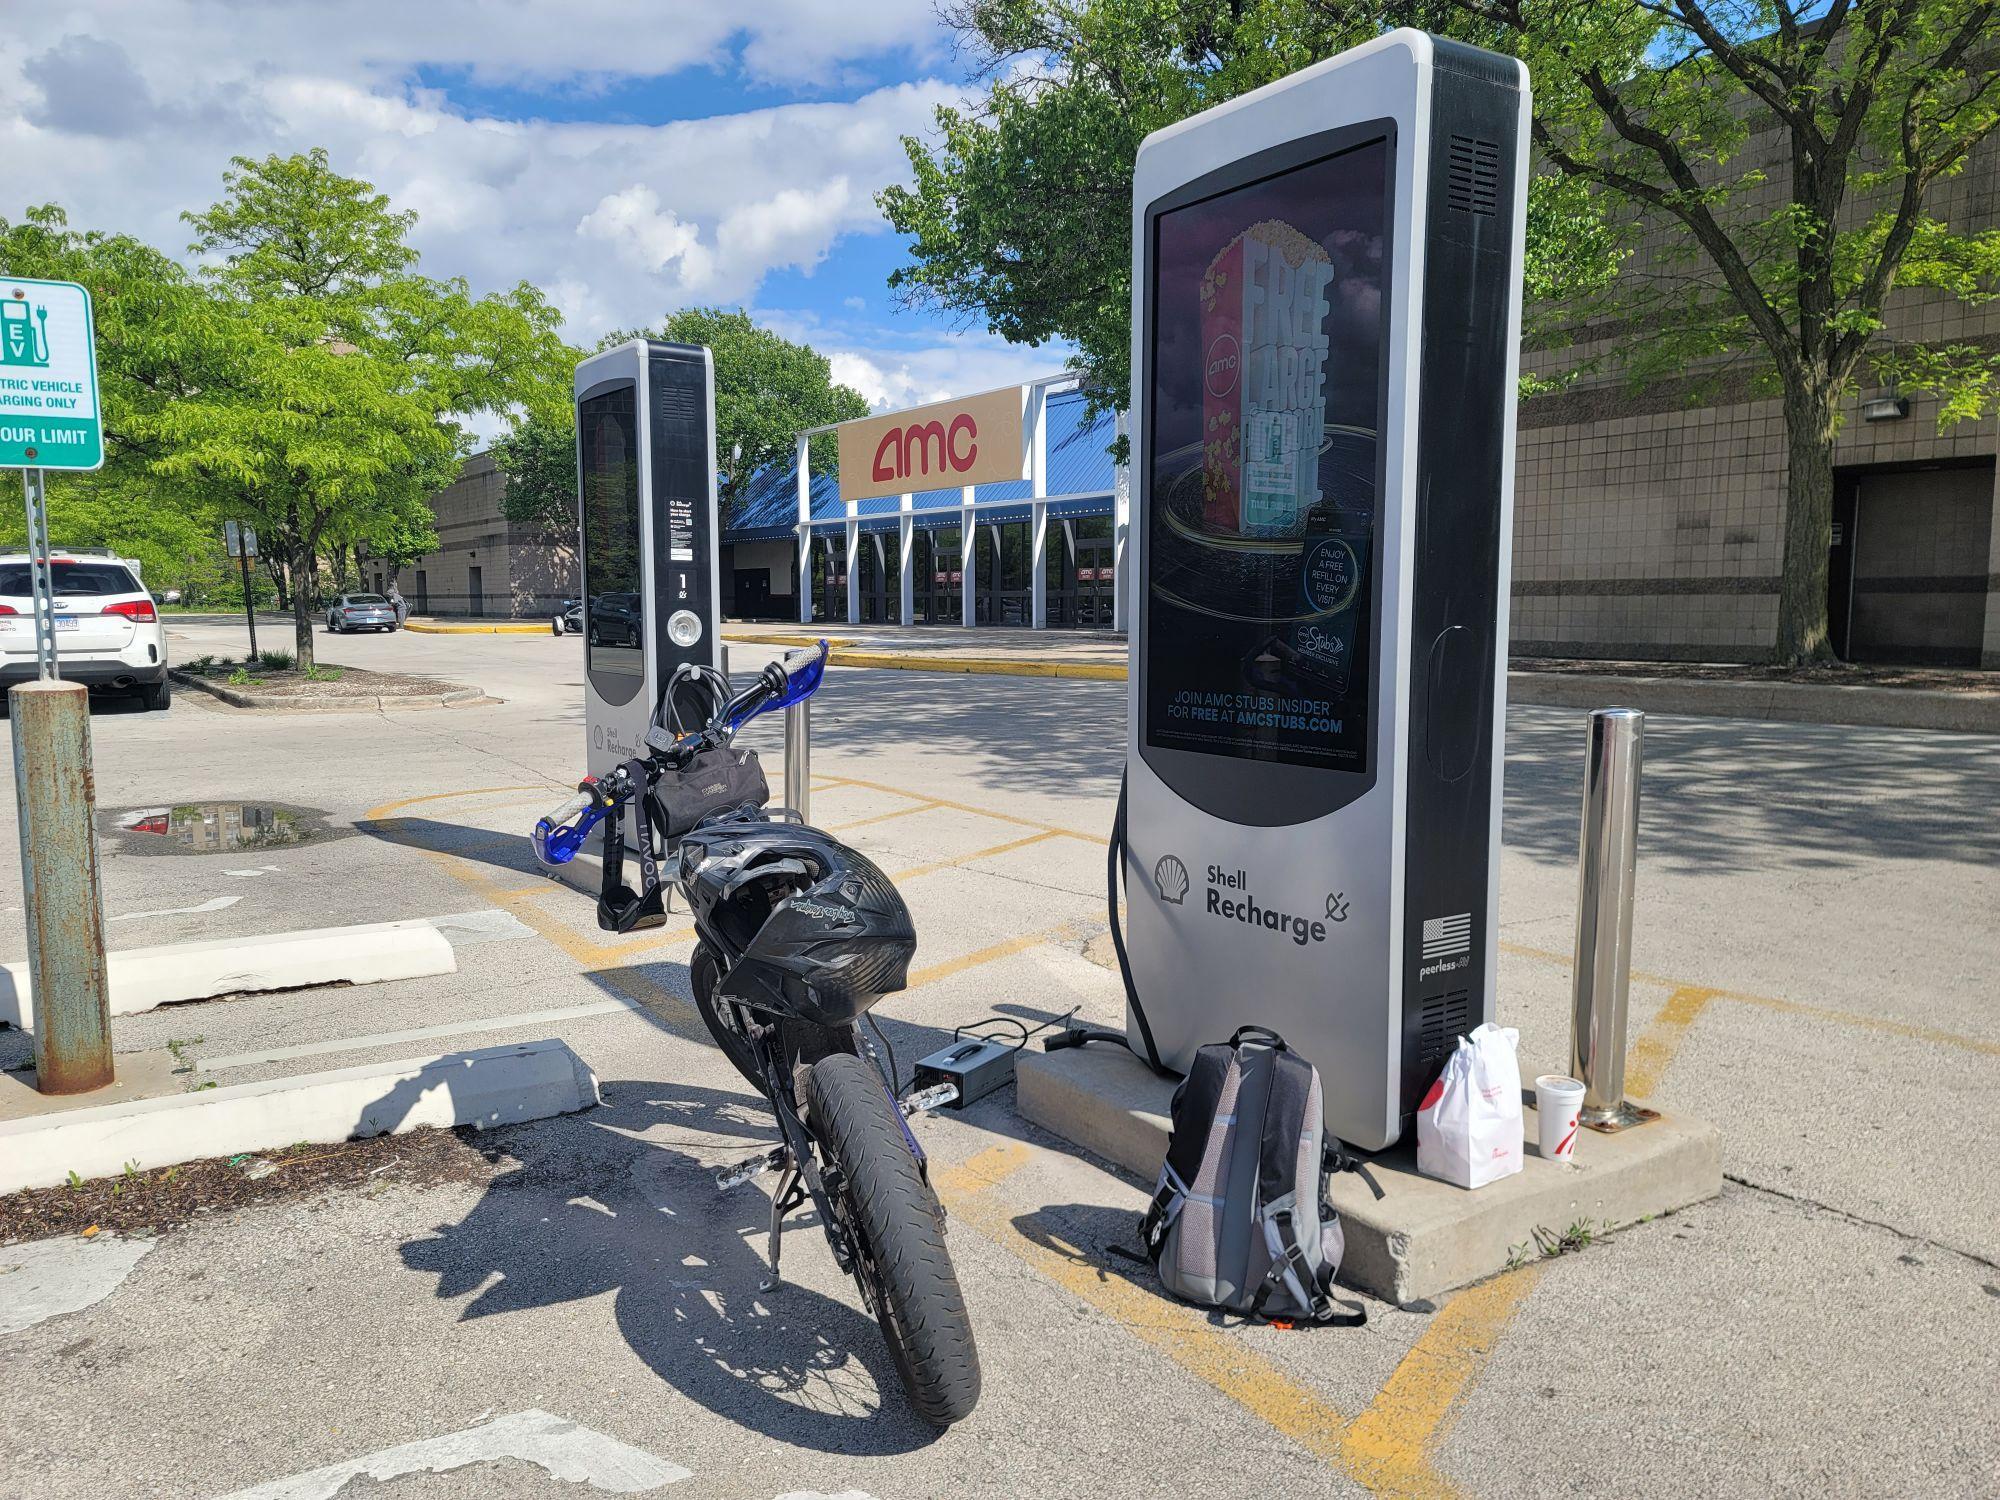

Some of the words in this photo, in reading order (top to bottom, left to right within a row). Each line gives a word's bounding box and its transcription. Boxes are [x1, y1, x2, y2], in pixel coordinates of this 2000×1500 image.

[31, 379, 83, 394] VEHICLE
[46, 397, 77, 409] ONLY
[41, 428, 88, 445] LIMIT
[1320, 548, 1346, 560] ENJOY
[1318, 560, 1325, 569] A
[1325, 561, 1344, 572] FREE
[680, 573, 686, 589] 1
[1311, 570, 1334, 582] REFILL
[1335, 574, 1348, 585] ON
[1316, 583, 1340, 594] EVERY
[1317, 594, 1336, 605] VISIT
[1306, 626, 1335, 653] Stubs
[1174, 690, 1203, 705] JOIN
[1204, 692, 1233, 707] AMC
[1235, 694, 1275, 711] STUBS
[1167, 704, 1189, 719] FOR
[1191, 706, 1218, 722] FREE
[1220, 709, 1235, 723] AT
[1237, 711, 1343, 734] AMCSTUBS.COM
[607, 738, 637, 760] Recharge
[1207, 864, 1247, 891] Shell
[1206, 887, 1327, 946] Recharge
